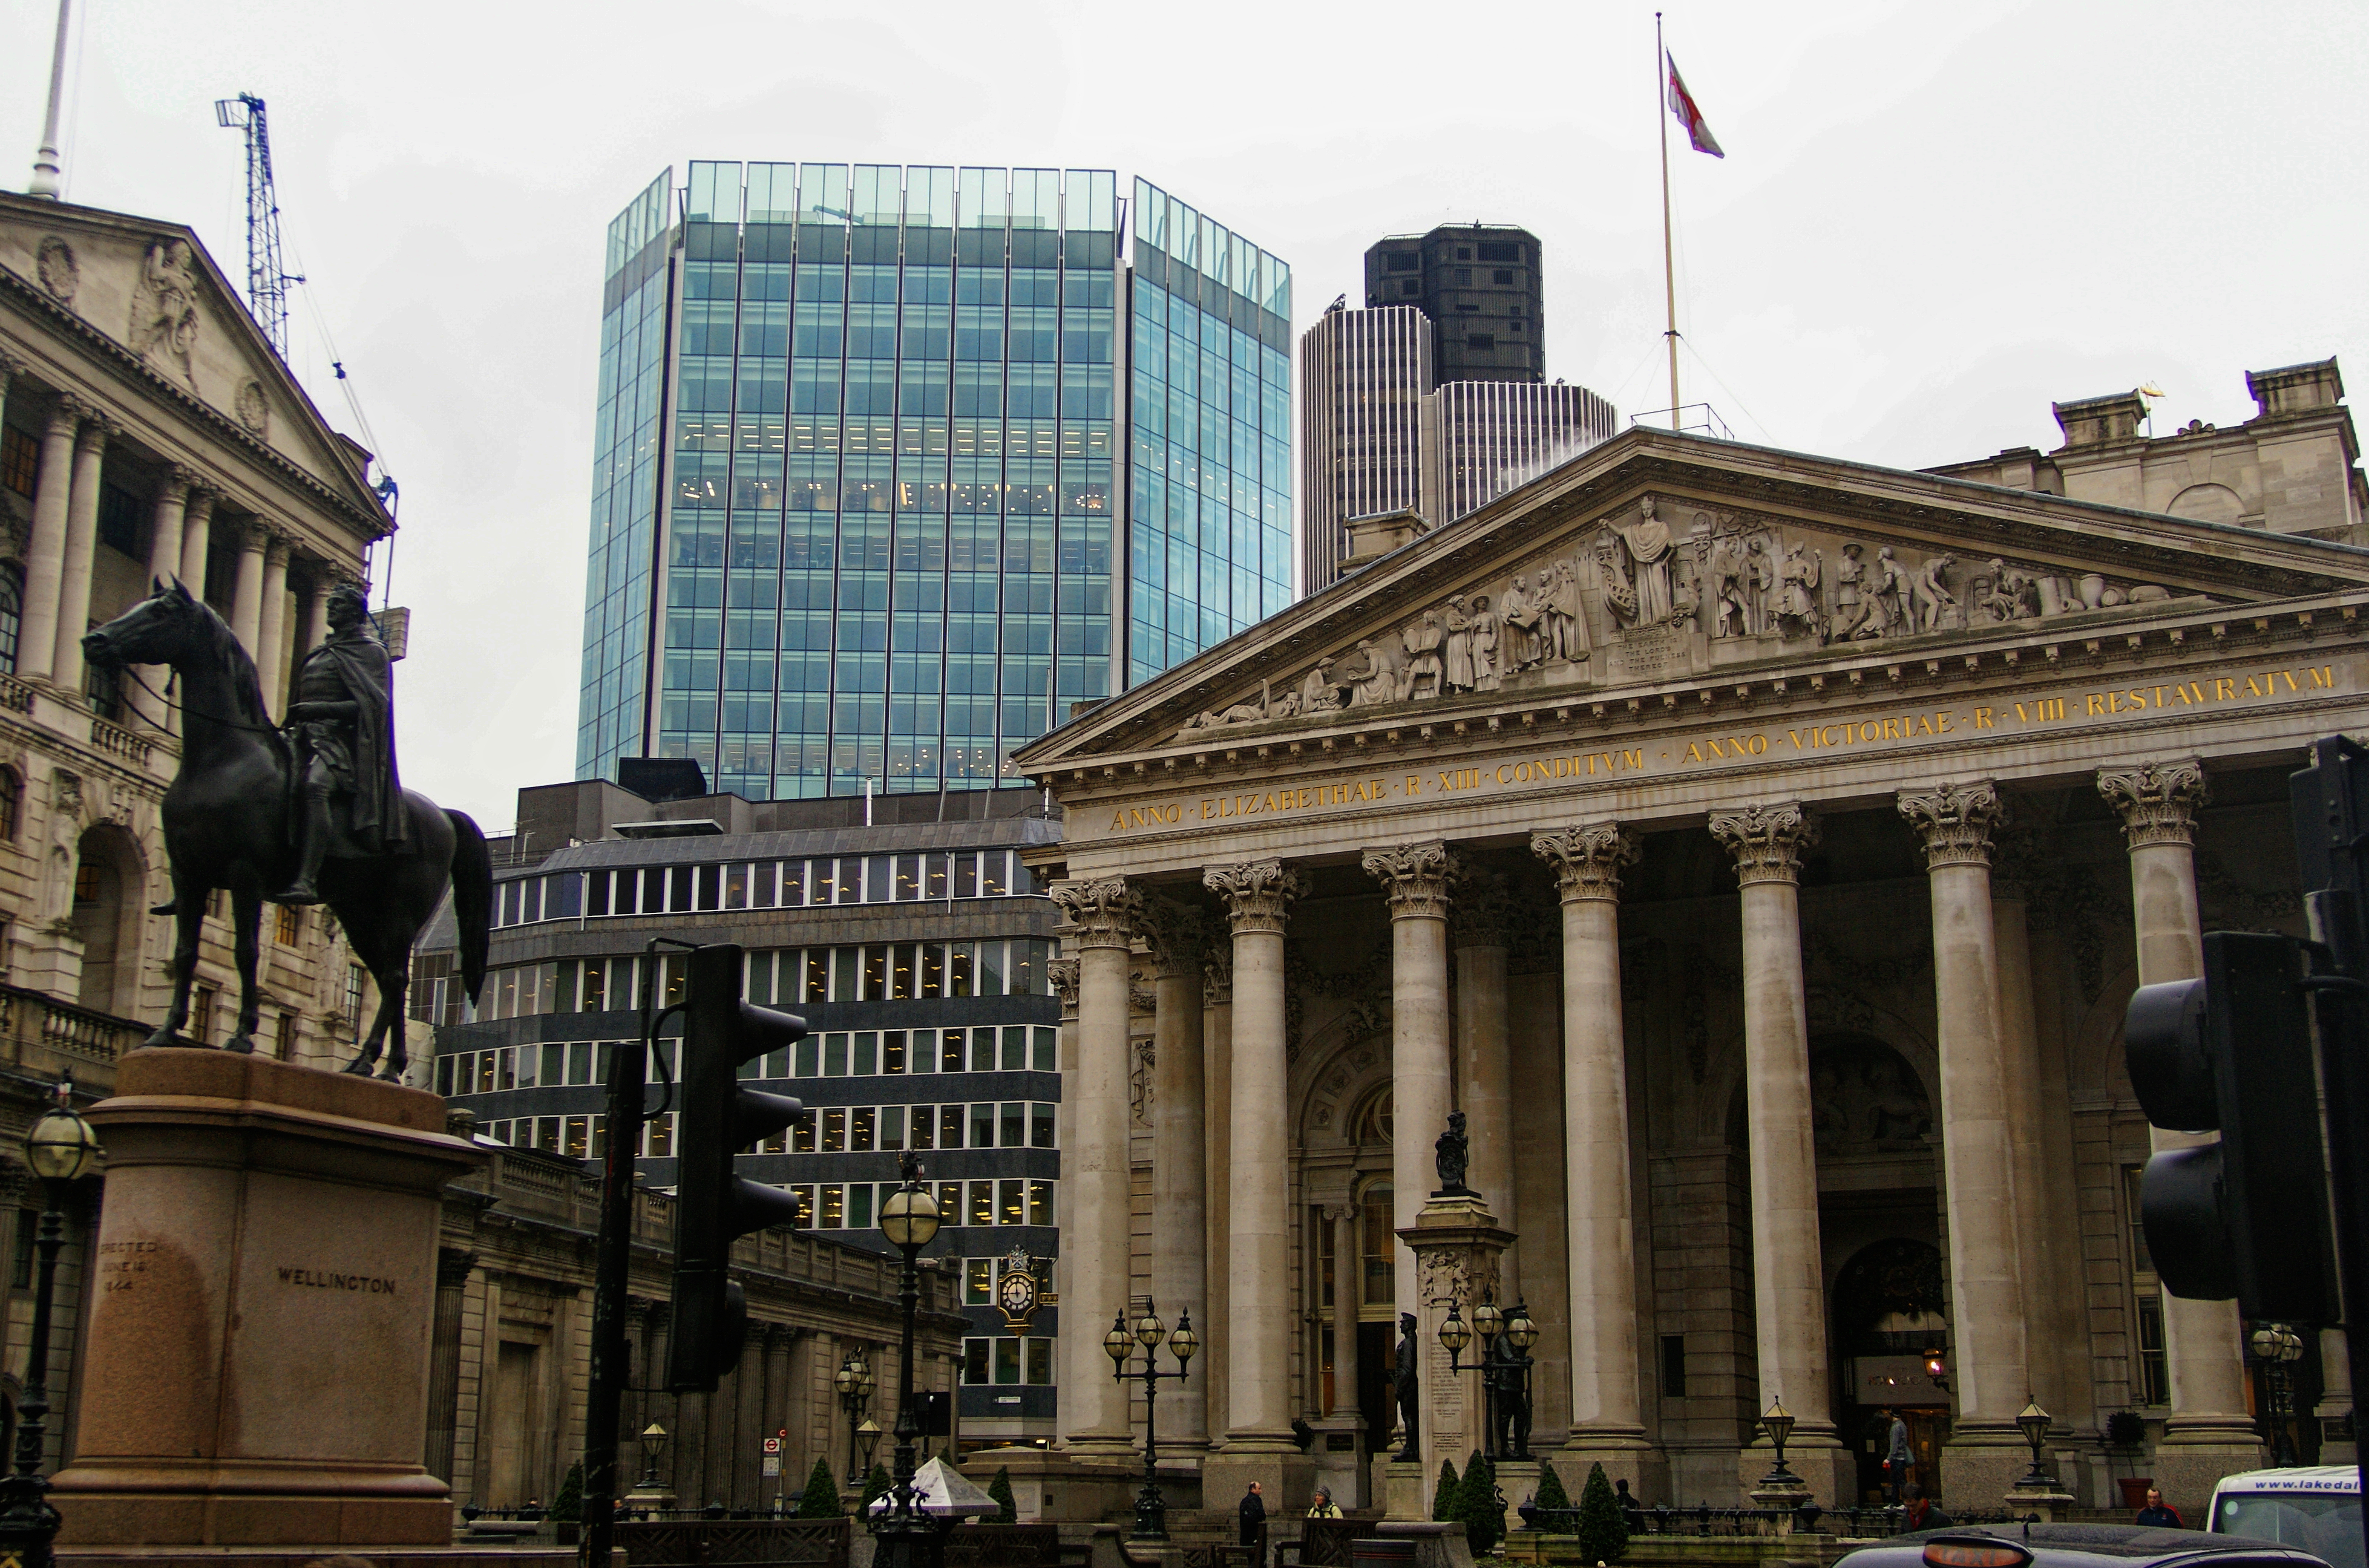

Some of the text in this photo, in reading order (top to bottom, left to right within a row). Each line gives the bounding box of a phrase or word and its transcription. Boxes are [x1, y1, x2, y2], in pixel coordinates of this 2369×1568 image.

[1637, 639, 1665, 648] EARTH
[1110, 665, 2336, 831] ANNO ELIZABETHAE R XIII CONDITVM ANNO VICTORIAE R VIII RESTAVRATVM
[278, 1267, 396, 1295] WELLINGTON
[2255, 1480, 2359, 1490] www.lakedal
[1940, 1547, 1997, 1566] TAXI
